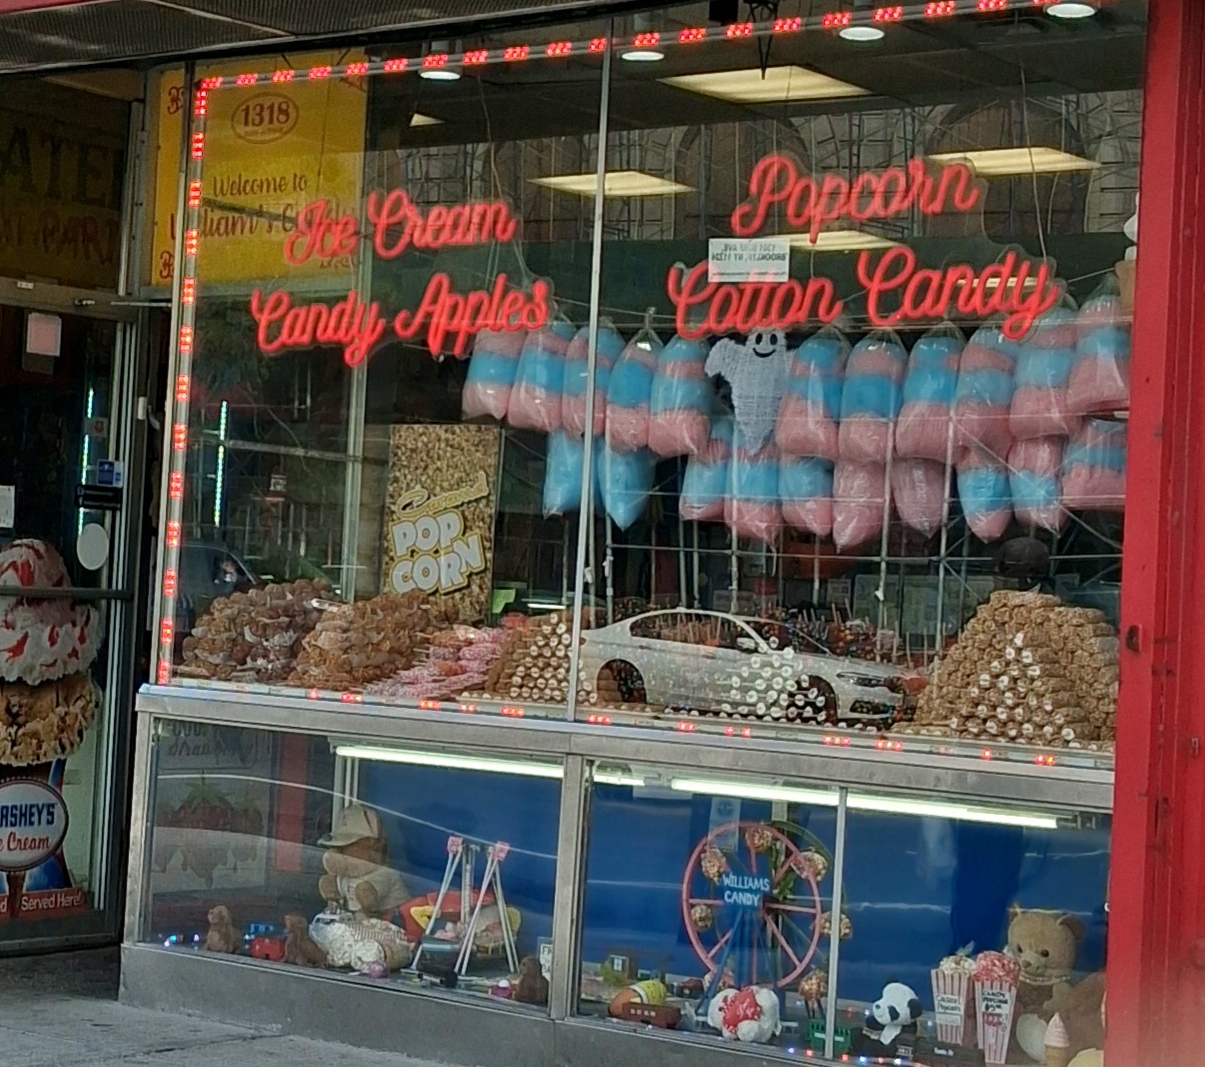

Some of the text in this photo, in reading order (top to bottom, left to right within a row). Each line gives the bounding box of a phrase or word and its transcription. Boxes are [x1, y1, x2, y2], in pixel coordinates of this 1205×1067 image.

[241, 101, 290, 128] 1318
[213, 172, 307, 198] Welcome to
[731, 154, 980, 244] Popcorn
[284, 198, 360, 265] Ice
[367, 188, 517, 259] Cream
[667, 247, 1059, 341] Cotton Candy
[251, 273, 549, 367] Candy Apples
[392, 511, 462, 557] POP
[391, 532, 484, 594] CORN
[7, 831, 52, 851] Cream
[722, 872, 770, 892] WILLIAMS
[724, 890, 761, 906] CANDY
[21, 895, 56, 911] Served
[57, 892, 82, 907] Here!
